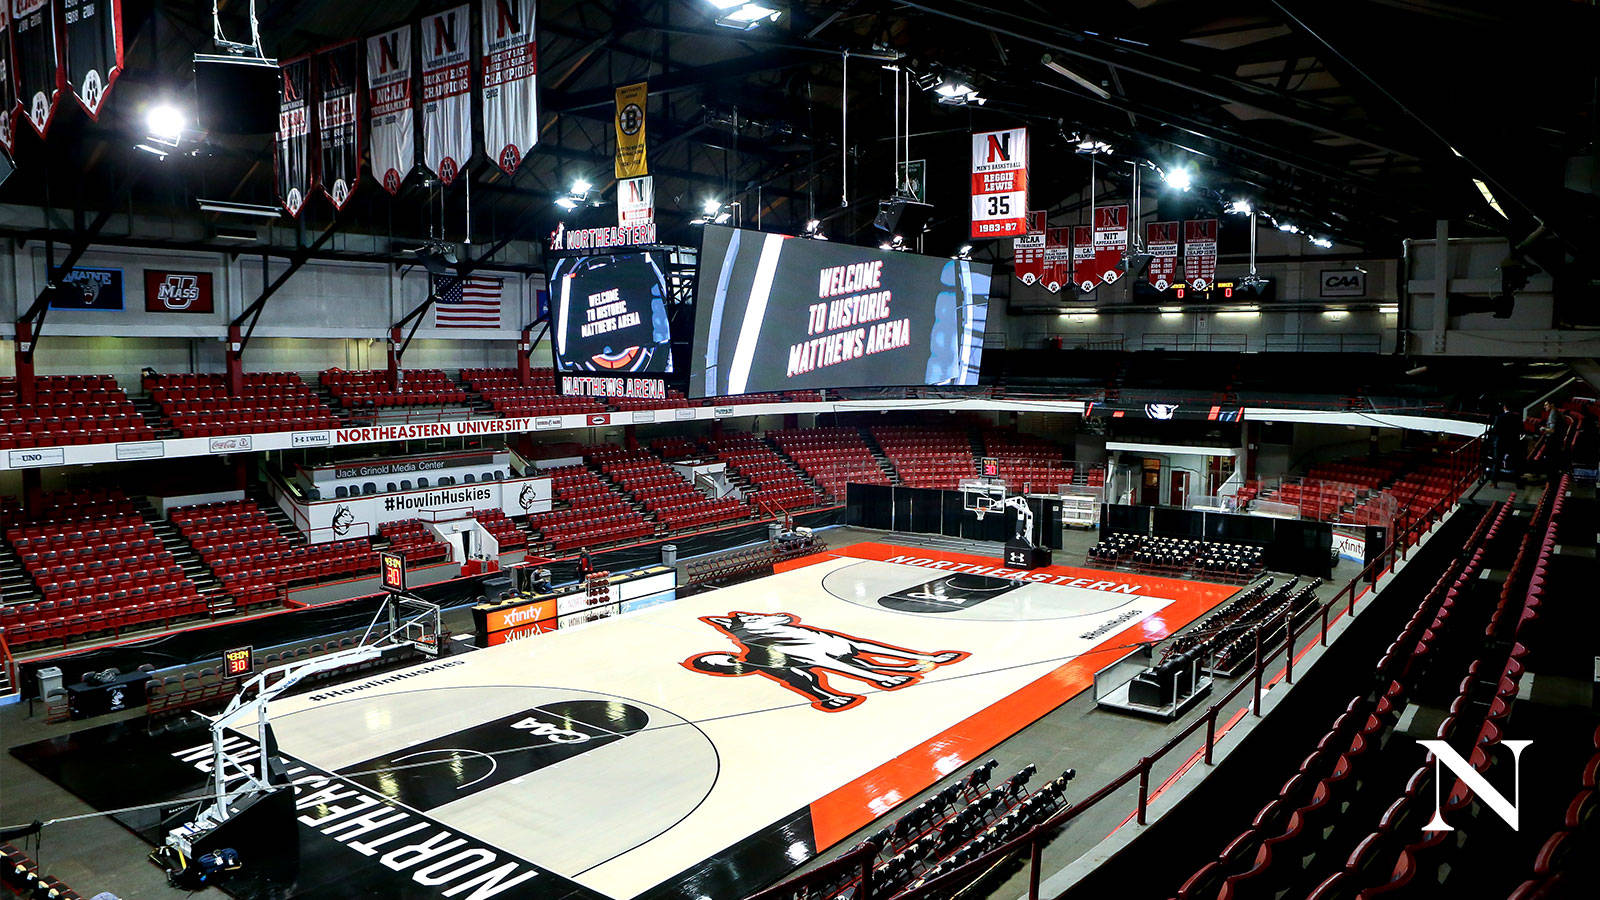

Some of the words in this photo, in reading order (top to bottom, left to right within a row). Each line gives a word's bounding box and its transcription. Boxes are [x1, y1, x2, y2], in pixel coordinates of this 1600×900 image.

[497, 0, 521, 38] N
[434, 11, 457, 56] N
[379, 31, 400, 74] N
[450, 65, 469, 80] EAST
[485, 62, 534, 87] CHAMPIONS
[376, 83, 405, 105] NCAA
[424, 78, 469, 100] CHAMPIONS
[987, 132, 1011, 162] N
[992, 162, 1021, 170] BASKETBALL
[984, 172, 1015, 182] REGGIE
[985, 181, 1014, 192] LEWIS
[987, 196, 1011, 216] 35
[1103, 207, 1119, 227] N
[566, 223, 656, 250] NORTHEASTERN
[1019, 236, 1041, 244] NCAA
[1103, 232, 1119, 240] NIT
[62, 271, 112, 285] MAINE
[819, 259, 884, 298] WELCOME
[1325, 276, 1360, 287] CAA
[588, 288, 620, 308] WELCOME
[1177, 289, 1185, 298] 0
[1225, 288, 1232, 297] 0
[586, 308, 596, 322] TO
[596, 300, 627, 320] HISTORIC
[807, 302, 828, 336] TO
[827, 290, 892, 331] HISTORIC
[581, 317, 617, 338] MATTHEWS
[617, 311, 641, 329] ARENA
[786, 327, 865, 378] MATTHEWS
[866, 318, 911, 355] ARENA
[562, 376, 624, 397] MATTHEWS
[625, 378, 666, 399] ARENA
[336, 422, 451, 443] NORTHEASTERN
[457, 418, 530, 435] UNIVERSITY
[22, 454, 42, 462] UNO
[336, 469, 357, 478] Jack
[360, 465, 389, 476] Grinold
[392, 462, 416, 472] Media
[418, 460, 444, 470] Center
[984, 465, 997, 475] 30
[384, 487, 491, 512] #HowlinHuskies
[1340, 539, 1365, 557] xfinity
[387, 567, 400, 586] 30
[884, 554, 1141, 595] NORTHEASTERN
[503, 606, 542, 626] xfinity
[232, 659, 246, 672] 30
[308, 659, 465, 701] #HowlinHuskies
[510, 716, 591, 743] CAA
